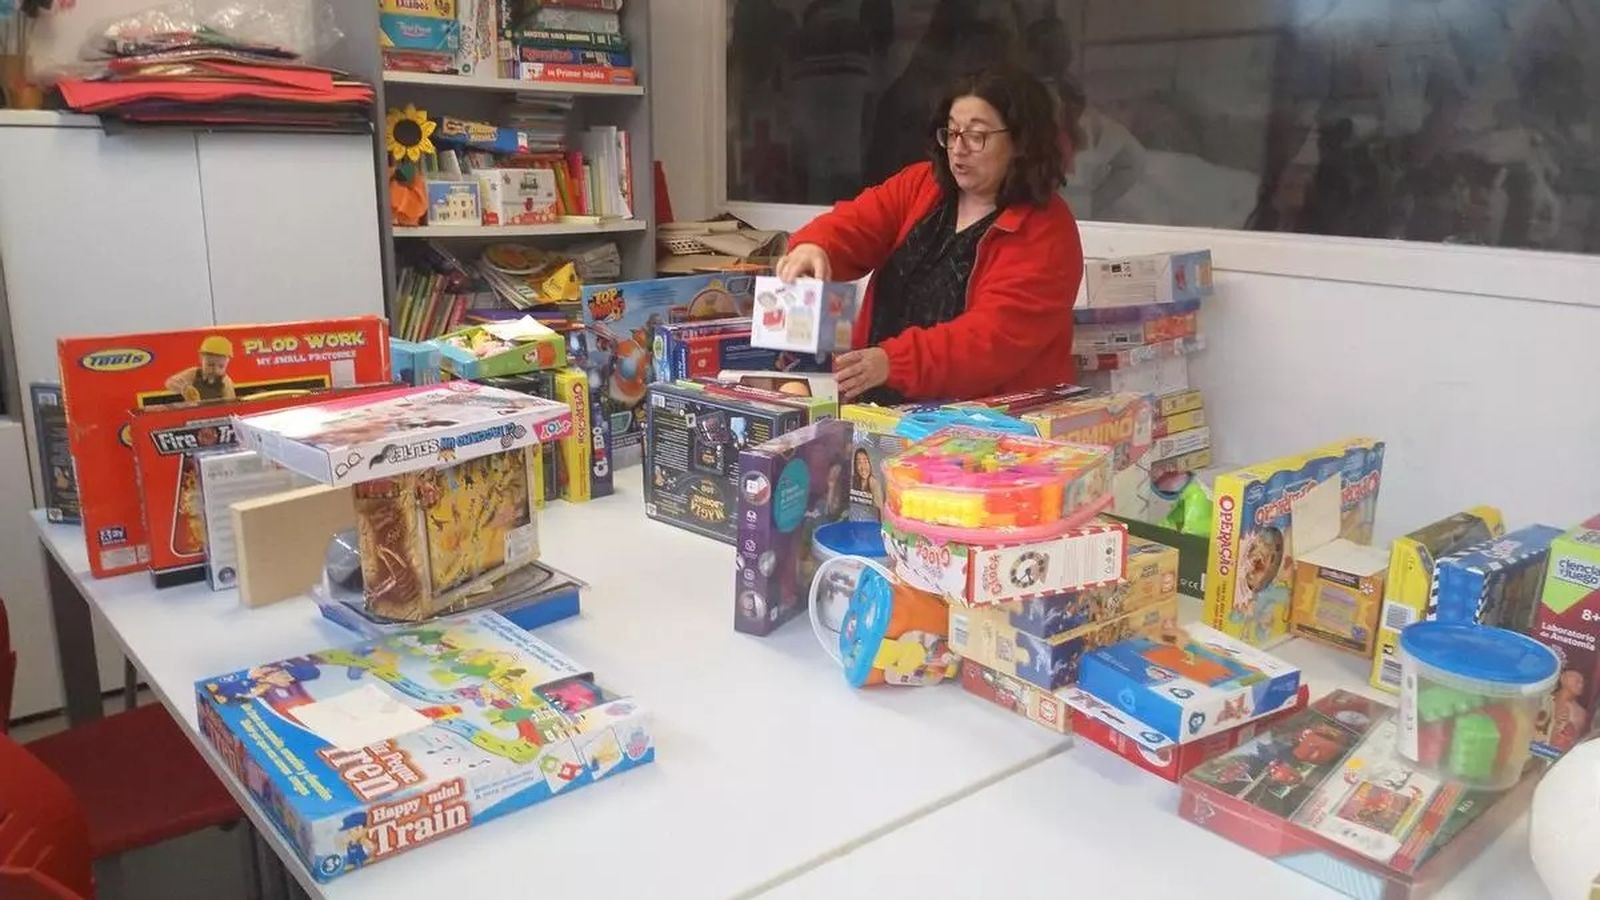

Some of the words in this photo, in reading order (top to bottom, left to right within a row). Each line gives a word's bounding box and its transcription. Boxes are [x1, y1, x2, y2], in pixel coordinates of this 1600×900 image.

[243, 336, 299, 354] PLOD
[304, 331, 366, 349] WORK
[89, 350, 144, 367] Tools
[256, 357, 271, 366] MY
[273, 354, 306, 364] SMALL
[157, 431, 198, 450] Fire
[1218, 494, 1236, 577] OPERAÇÃO
[1541, 621, 1596, 643] Laboratorio
[372, 798, 421, 824] Happy
[427, 781, 461, 804] mini
[368, 803, 468, 857] Train
